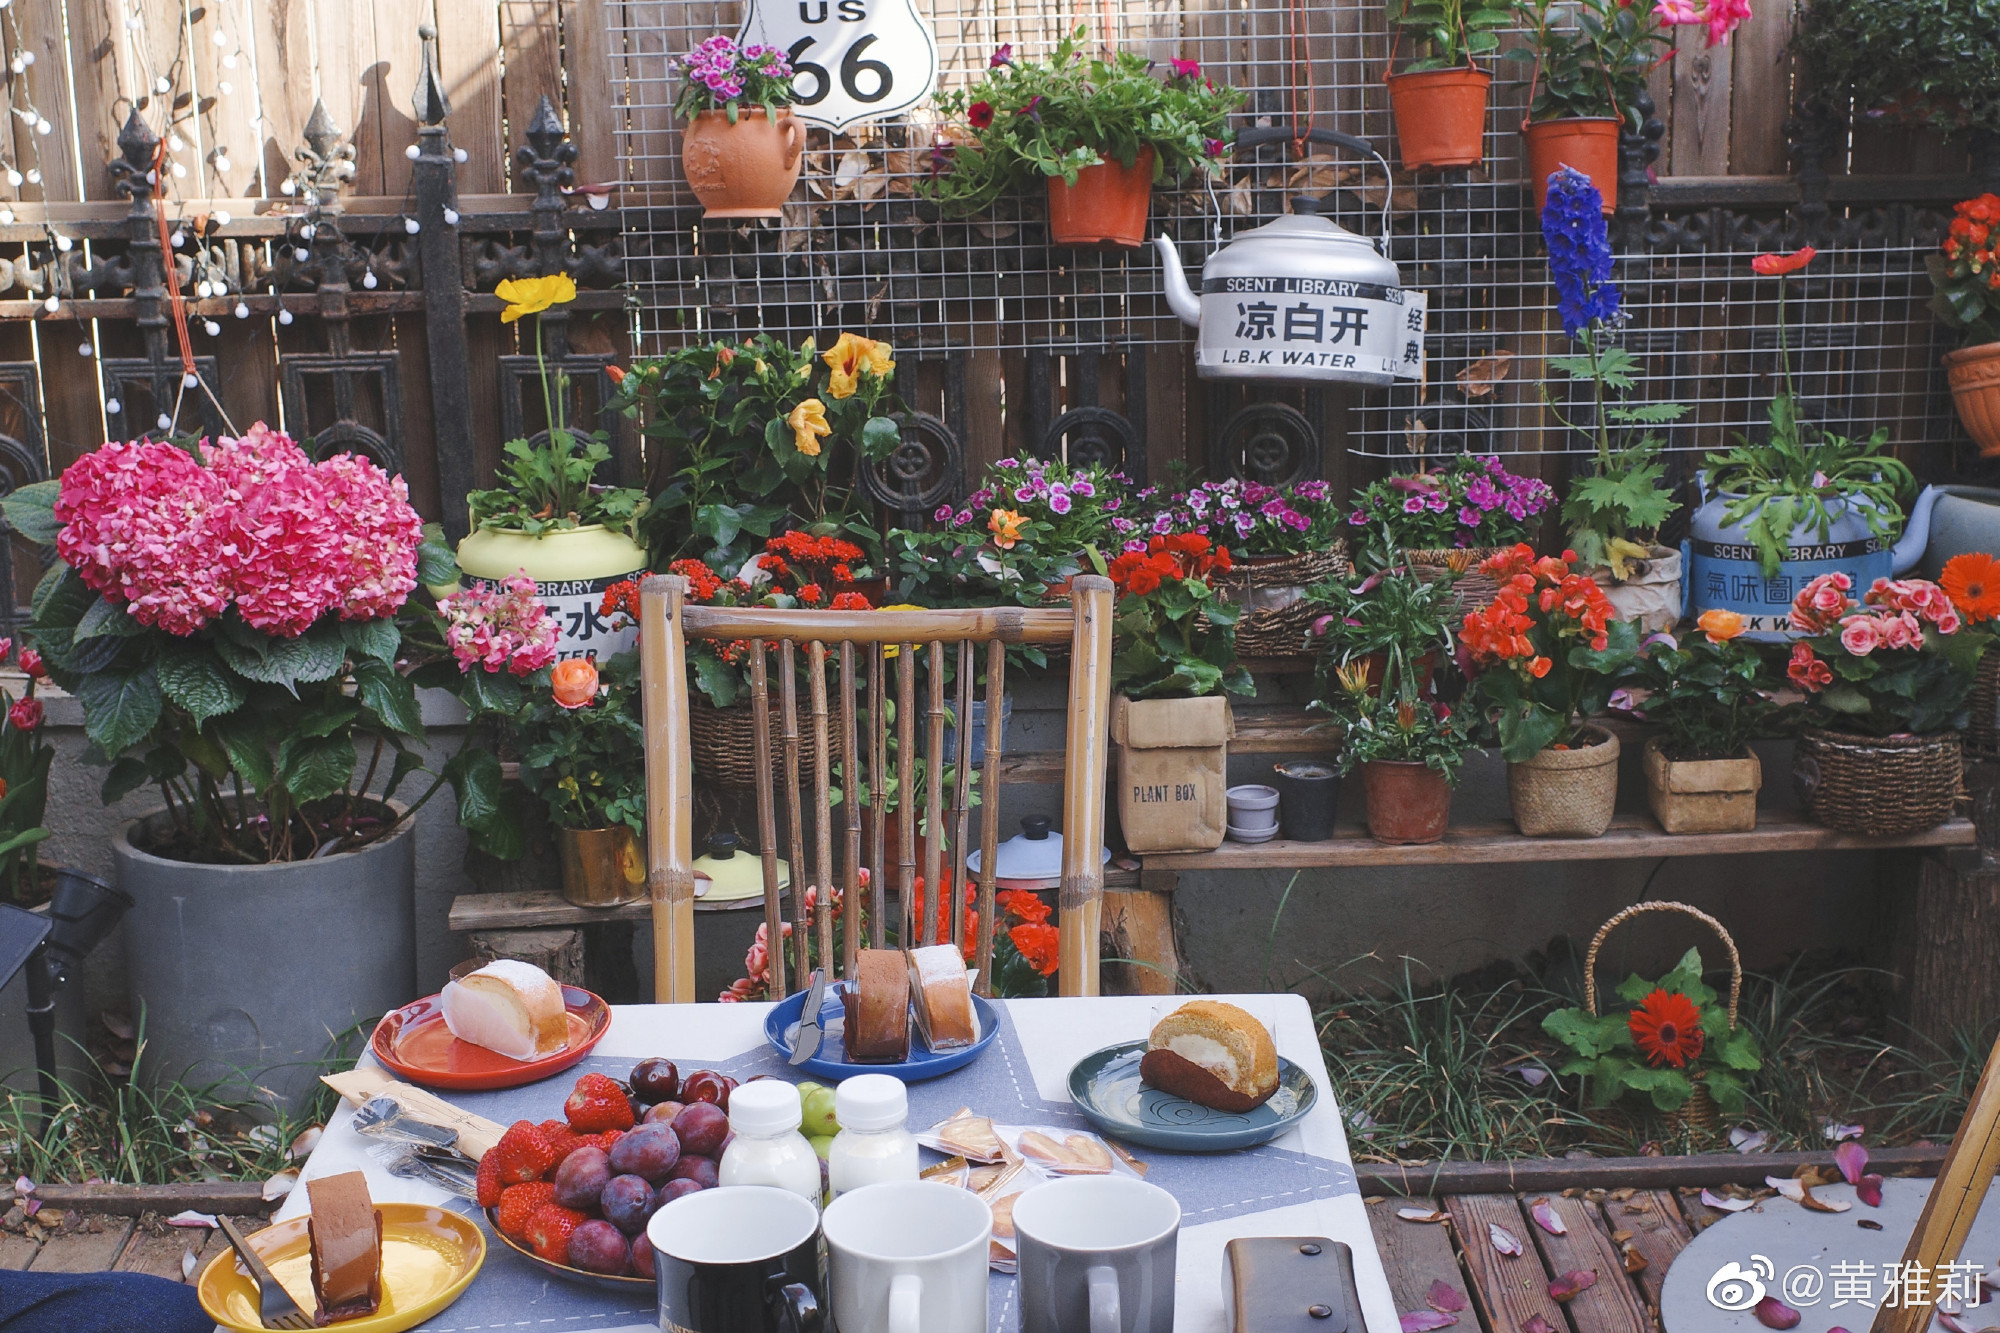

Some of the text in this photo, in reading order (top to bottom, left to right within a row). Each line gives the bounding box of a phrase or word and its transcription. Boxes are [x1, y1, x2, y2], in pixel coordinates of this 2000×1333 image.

[800, 0, 867, 23] US
[787, 34, 893, 106] 66
[1226, 278, 1359, 297] SCENT LIBRARY
[1235, 300, 1369, 347] 凉白开
[1403, 307, 1423, 365] 经典
[1222, 349, 1357, 369] L.B.K WATER
[1785, 544, 1847, 562] BRARY
[534, 579, 594, 597] BRARY
[554, 648, 598, 663] TER
[1133, 783, 1197, 803] PLANT BOX
